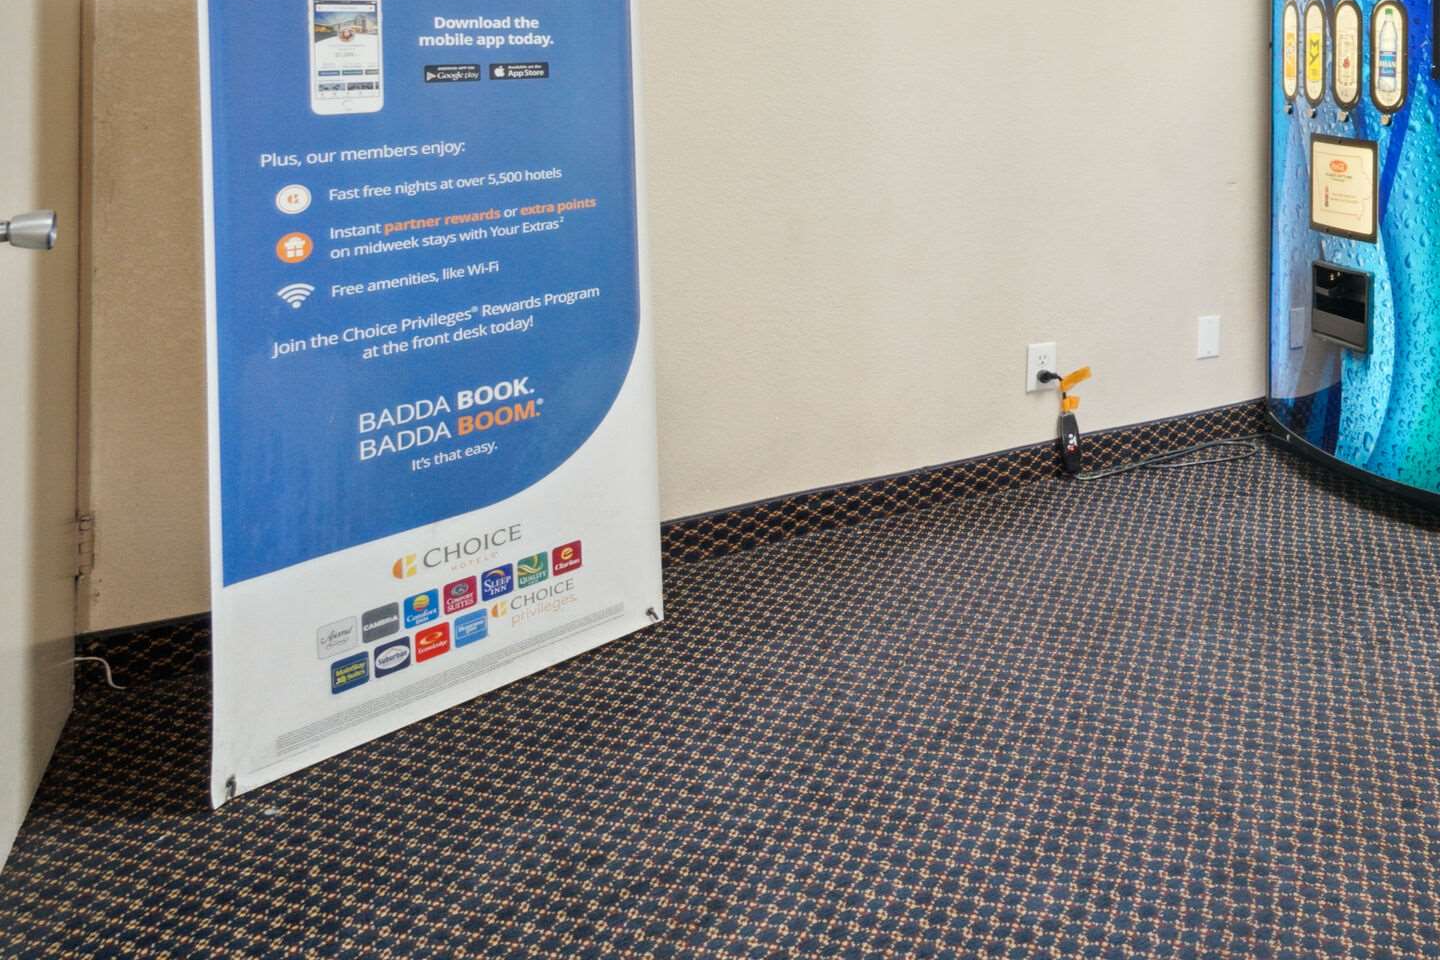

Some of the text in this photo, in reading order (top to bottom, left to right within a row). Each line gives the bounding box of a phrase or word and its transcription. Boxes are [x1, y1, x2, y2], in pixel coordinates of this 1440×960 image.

[433, 16, 541, 30] Download the
[418, 33, 555, 50] mobile app today.
[437, 71, 479, 81] Google play
[508, 69, 545, 79] App Store
[260, 141, 465, 169] Plus, our members enjoy:
[329, 167, 562, 202] Fast free nights at over 5,500 hotels
[329, 197, 597, 240] Instant partner rewards or extra points
[330, 246, 351, 259] on
[354, 237, 420, 256] midweek
[422, 233, 457, 250] stays
[459, 227, 488, 242] with
[490, 224, 520, 239] Your
[331, 260, 500, 298] Free amenities, like Wi-Fi
[272, 337, 307, 359] Join
[311, 333, 339, 349] the
[342, 323, 398, 344] Choice
[482, 296, 541, 318] Rewards
[544, 286, 601, 309] Program
[362, 315, 534, 360] at the front desk today!
[359, 376, 535, 434] BADDA BOOK.
[360, 422, 452, 461] BADDA
[412, 440, 498, 471] It's that easy.
[423, 524, 522, 568] CHOICE
[510, 578, 575, 610] CHOICE
[511, 595, 577, 628] privileges
